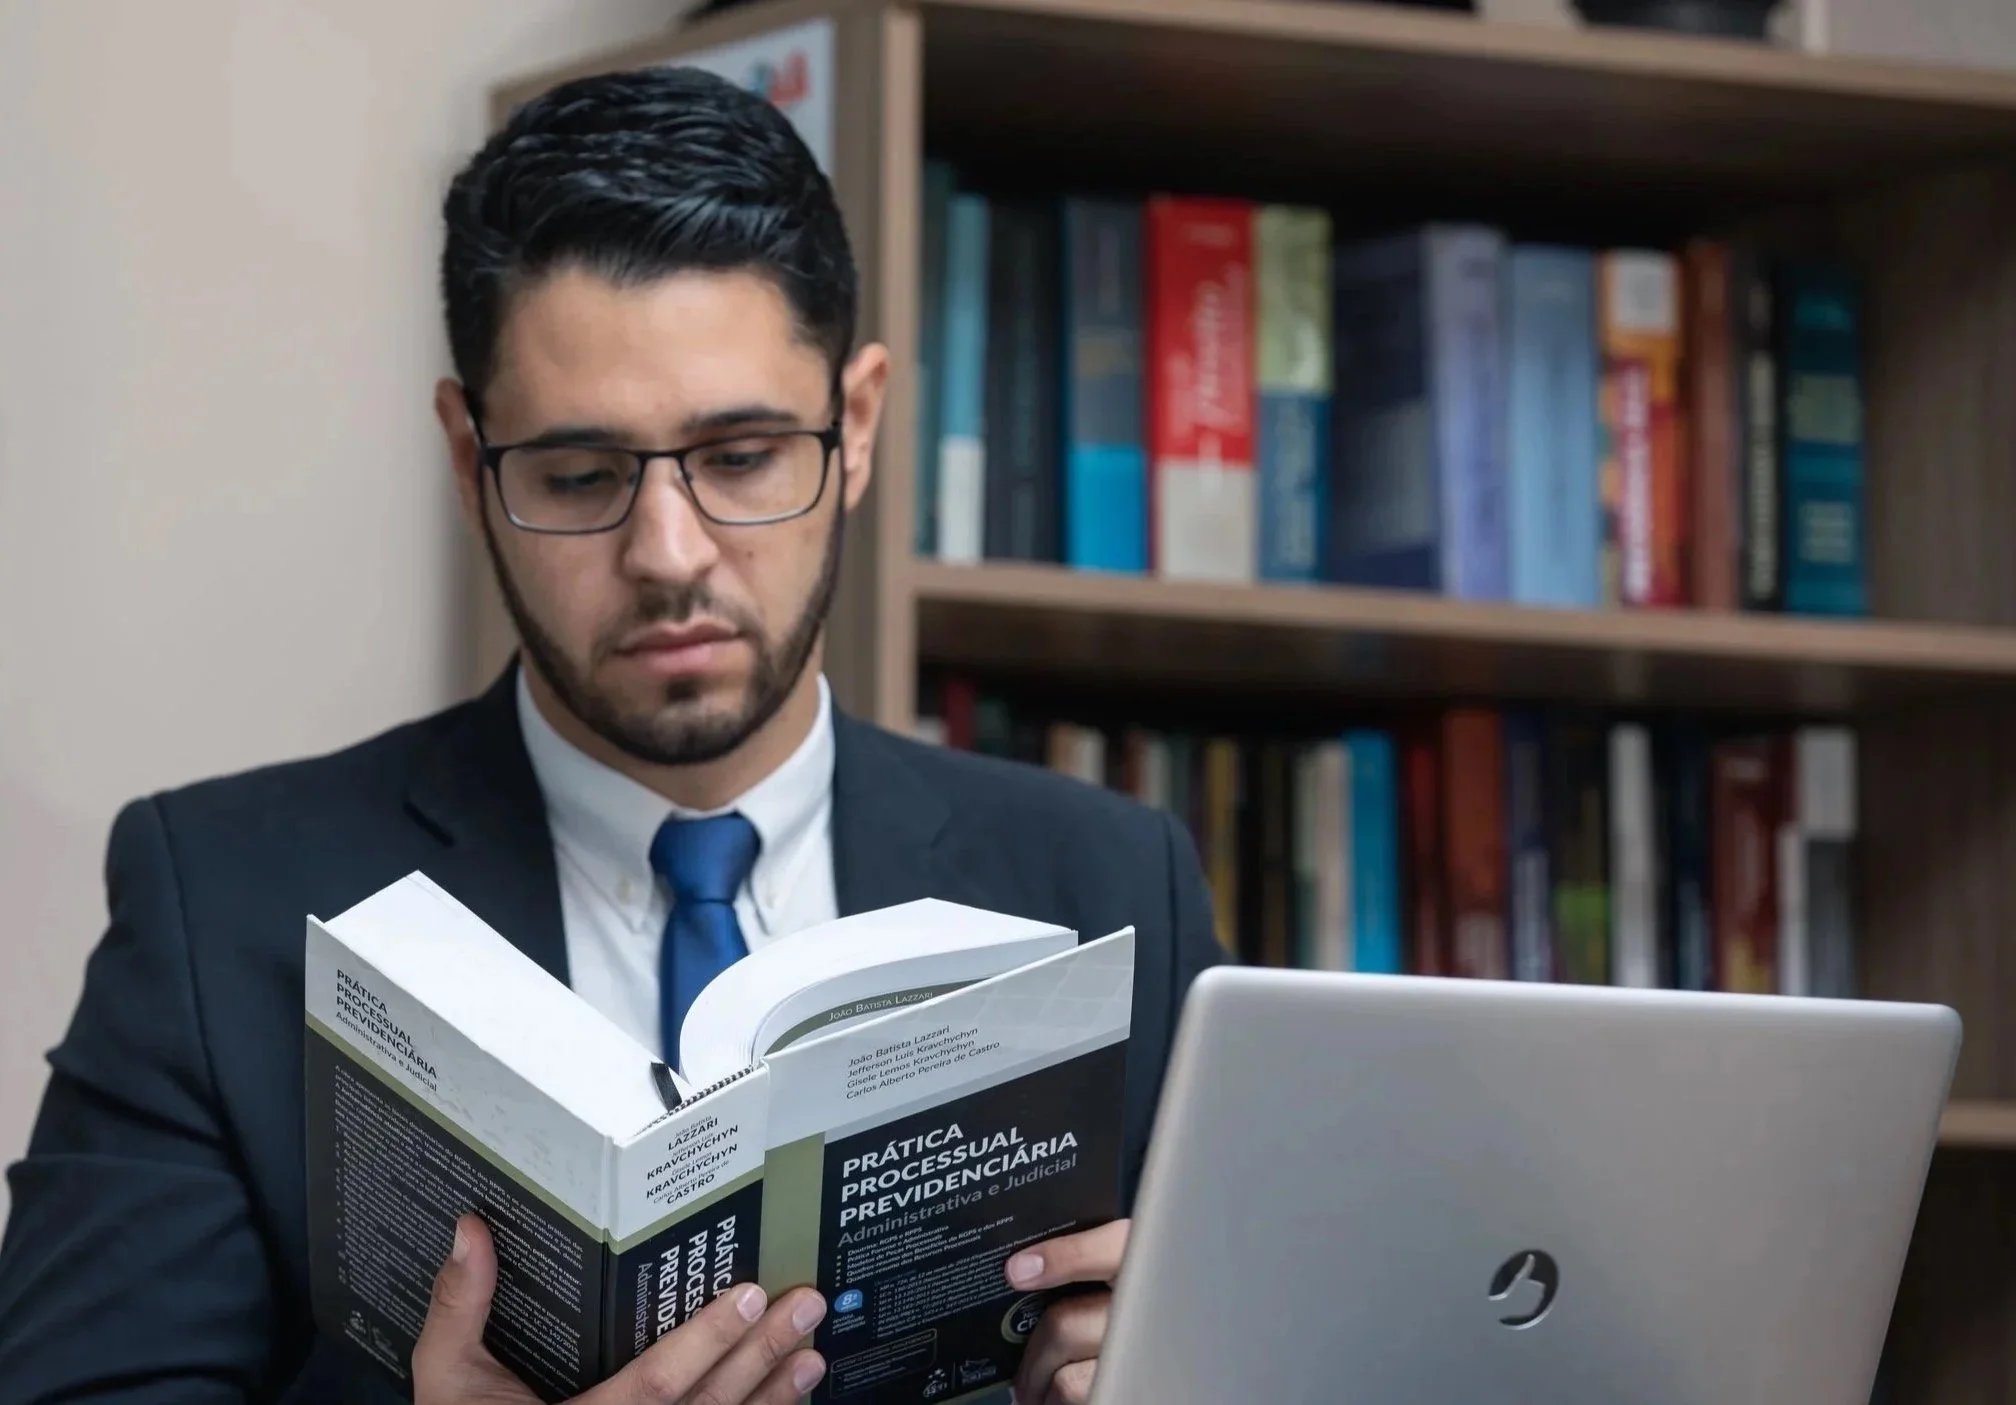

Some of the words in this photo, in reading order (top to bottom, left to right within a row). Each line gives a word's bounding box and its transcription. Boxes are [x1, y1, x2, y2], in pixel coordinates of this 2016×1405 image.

[337, 969, 388, 1015] PRÁTICA
[337, 983, 414, 1047] PROCESSUAL
[336, 996, 437, 1079] PREVIDENCIÁRIA
[336, 1012, 397, 1061] Administrativa
[406, 1064, 437, 1092] Judicial
[847, 1073, 876, 1089] Gisele
[880, 1062, 910, 1078] Lemos
[914, 1040, 974, 1067] Kravchychyn
[848, 1058, 892, 1078] Jefferson
[917, 1028, 978, 1055] Kravchychyn
[849, 1054, 872, 1068] João
[876, 1041, 911, 1058] Batista
[915, 1025, 950, 1044] Lazzari
[847, 1085, 876, 1100] Carlos
[879, 1071, 915, 1090] Alberto
[918, 1059, 951, 1077] Pereira
[954, 1053, 966, 1063] de
[969, 1042, 1000, 1057] Castro
[647, 1125, 738, 1180] KRAVCHYCHYN
[668, 1117, 718, 1151] LAZZARI
[843, 1123, 964, 1178] PRÁTICA
[646, 1144, 737, 1198] KRAVCHYCHYN
[667, 1174, 715, 1204] CASTRO
[840, 1131, 1078, 1228] PREVIDENCIÁRIA
[841, 1127, 1023, 1203] PROCESSUAL
[838, 1191, 983, 1248] Administrativa
[988, 1184, 999, 1196] e
[1004, 1153, 1077, 1191] Judicial
[657, 1245, 680, 1339] PREVIDE
[685, 1230, 708, 1321] PROCES
